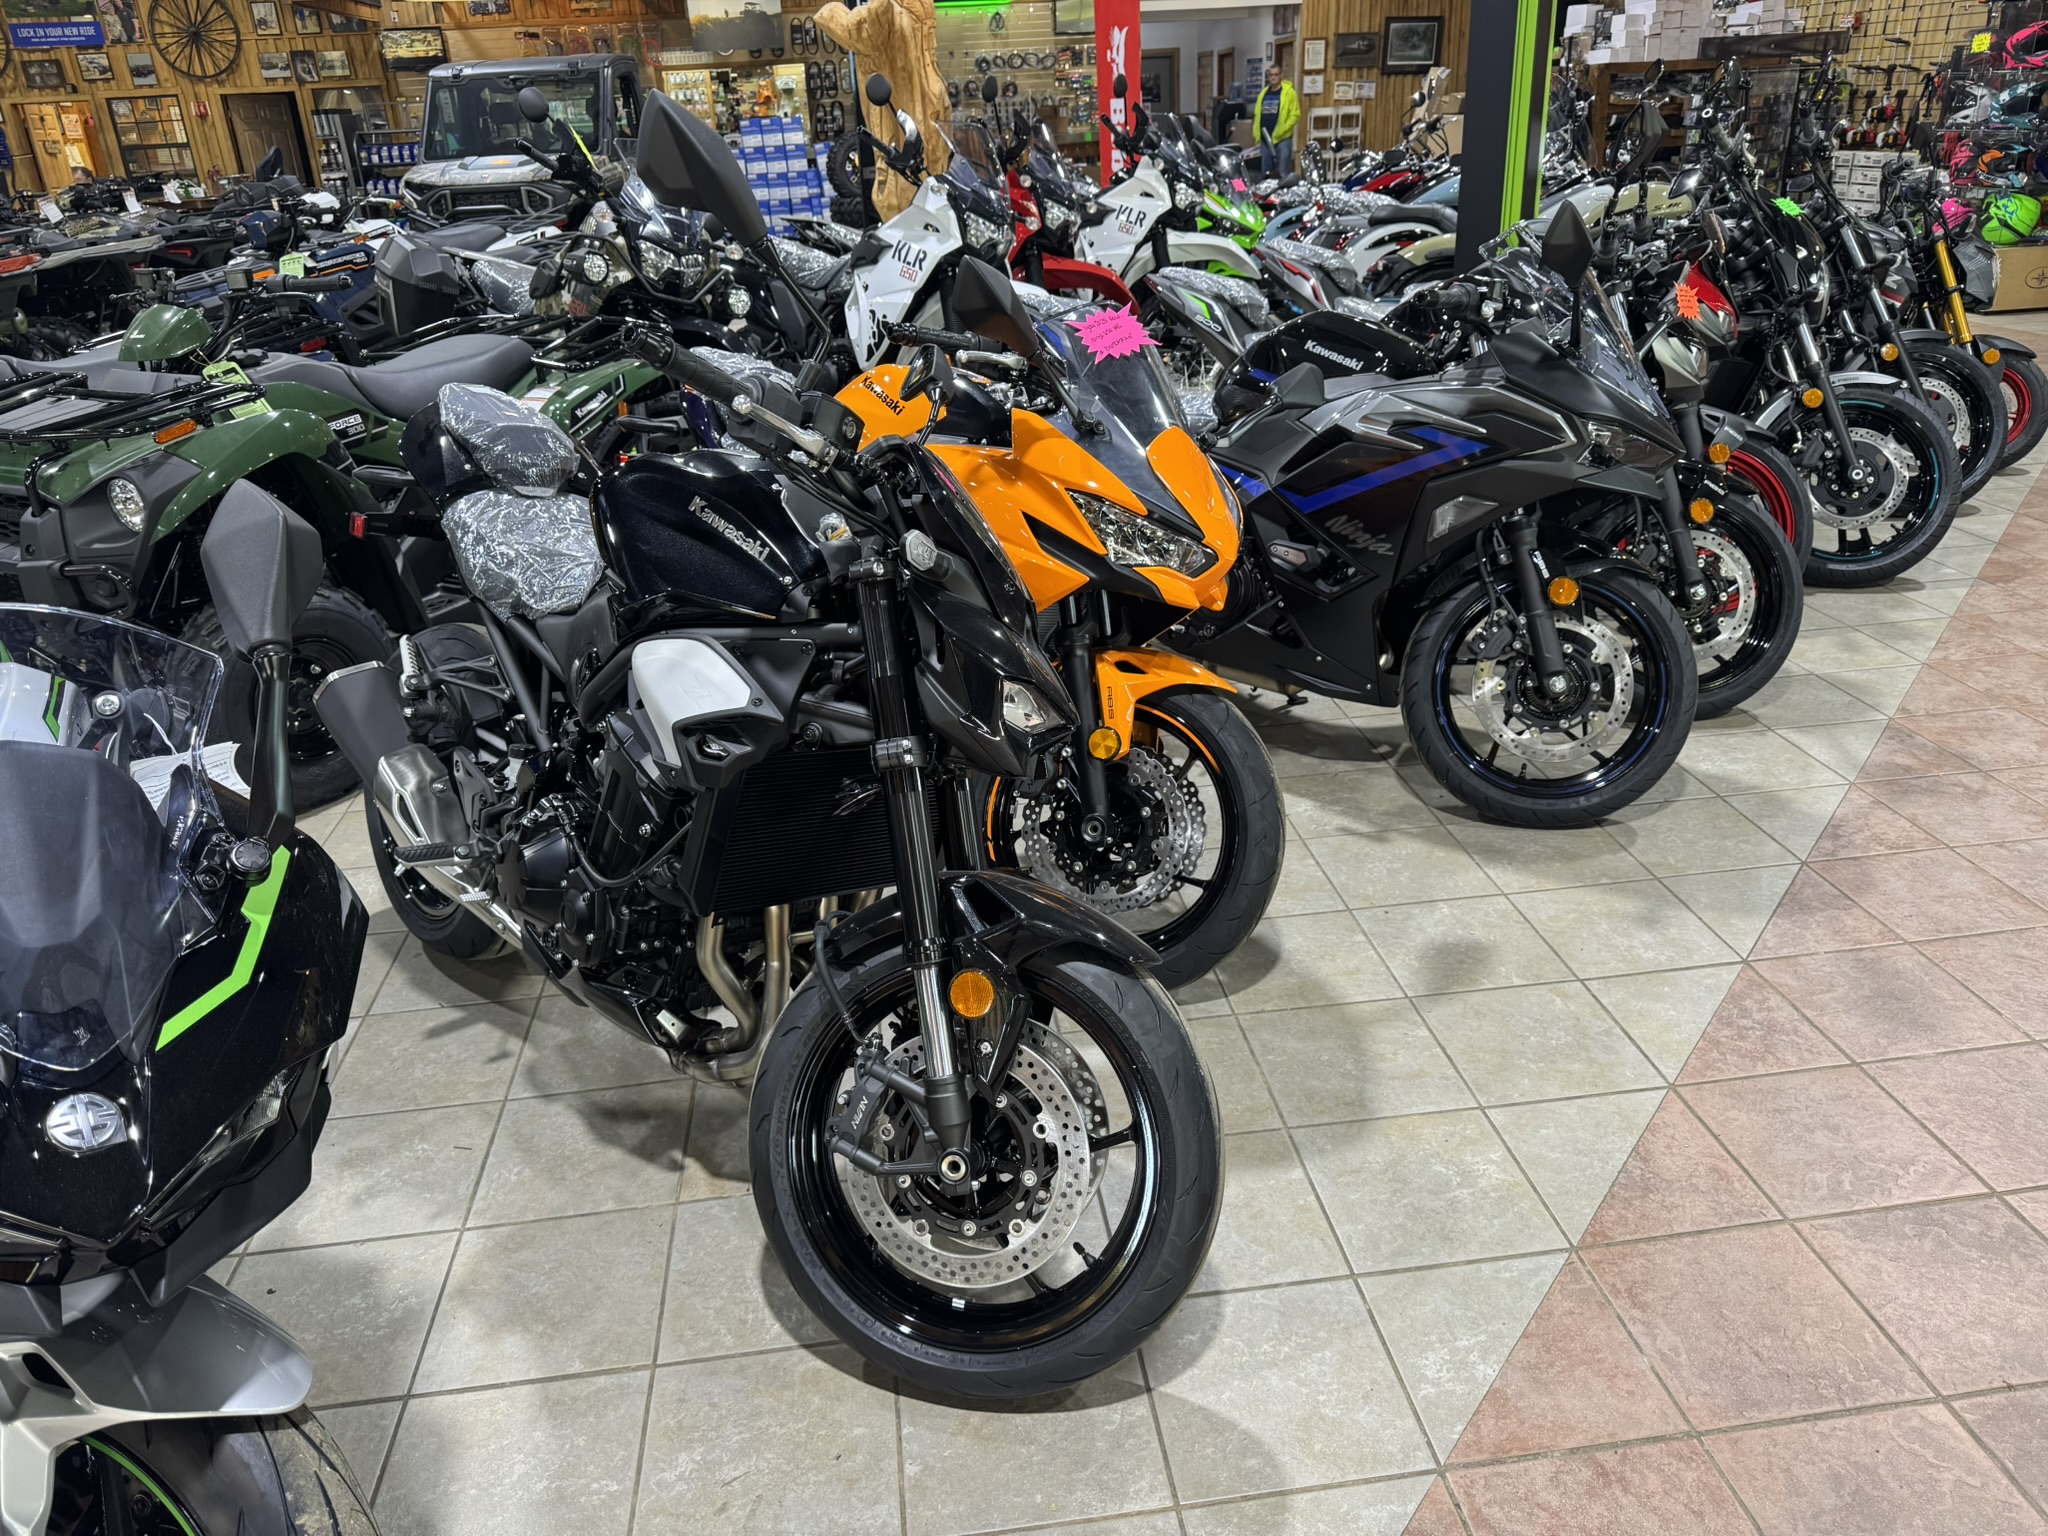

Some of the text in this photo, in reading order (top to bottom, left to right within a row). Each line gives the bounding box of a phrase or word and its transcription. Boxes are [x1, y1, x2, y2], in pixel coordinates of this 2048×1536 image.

[17, 26, 97, 38] LOCK IN YOUR NEW RIDE
[1115, 204, 1147, 229] KLR
[891, 239, 928, 272] KLR
[899, 264, 919, 283] 650
[1303, 339, 1365, 372] Kawasaki
[574, 389, 609, 419] Kawasaki
[860, 374, 906, 416] Kawasaki
[346, 423, 366, 436] 300
[688, 495, 770, 562] Kawasaki
[1324, 514, 1394, 556] Ninja
[1106, 685, 1115, 720] ABS
